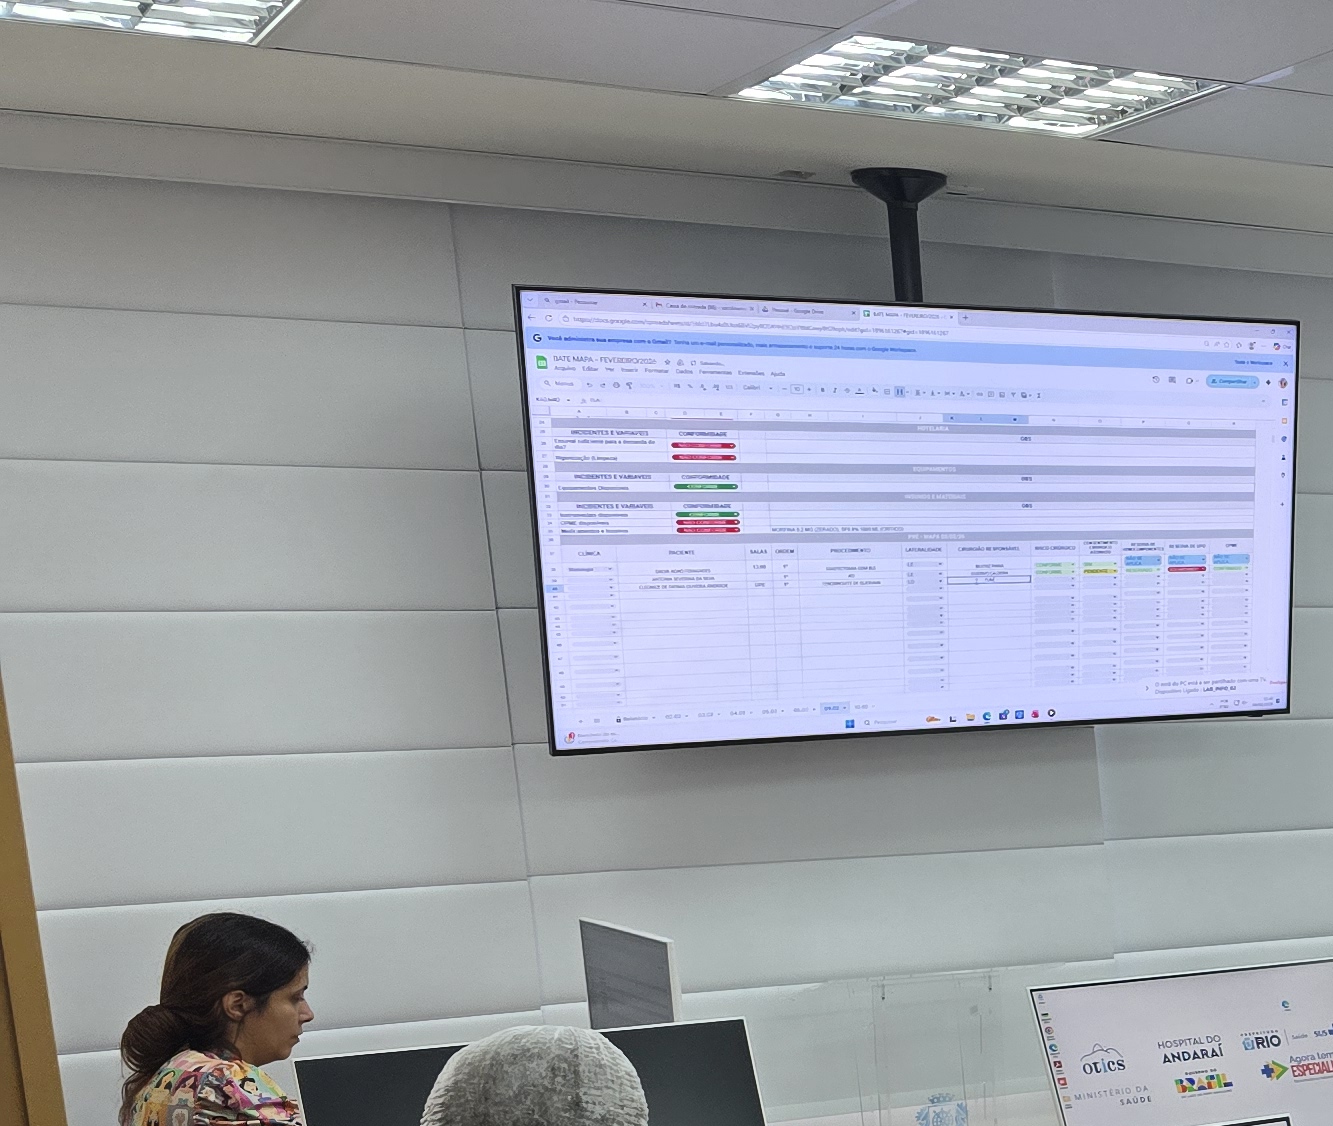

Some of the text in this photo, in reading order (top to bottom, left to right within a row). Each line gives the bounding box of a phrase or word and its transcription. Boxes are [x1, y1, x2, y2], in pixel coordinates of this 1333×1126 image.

[1158, 1034, 1221, 1049] HOSPITAL DO
[1255, 1035, 1281, 1049] RIO
[1163, 1043, 1224, 1064] ANDARAÍ
[1290, 1054, 1315, 1064] Agora
[1083, 1058, 1125, 1075] otics
[1174, 1073, 1234, 1093] BRASIL
[1074, 1087, 1131, 1101] MINISTÉRIO
[1120, 1096, 1151, 1105] SAÚDE
